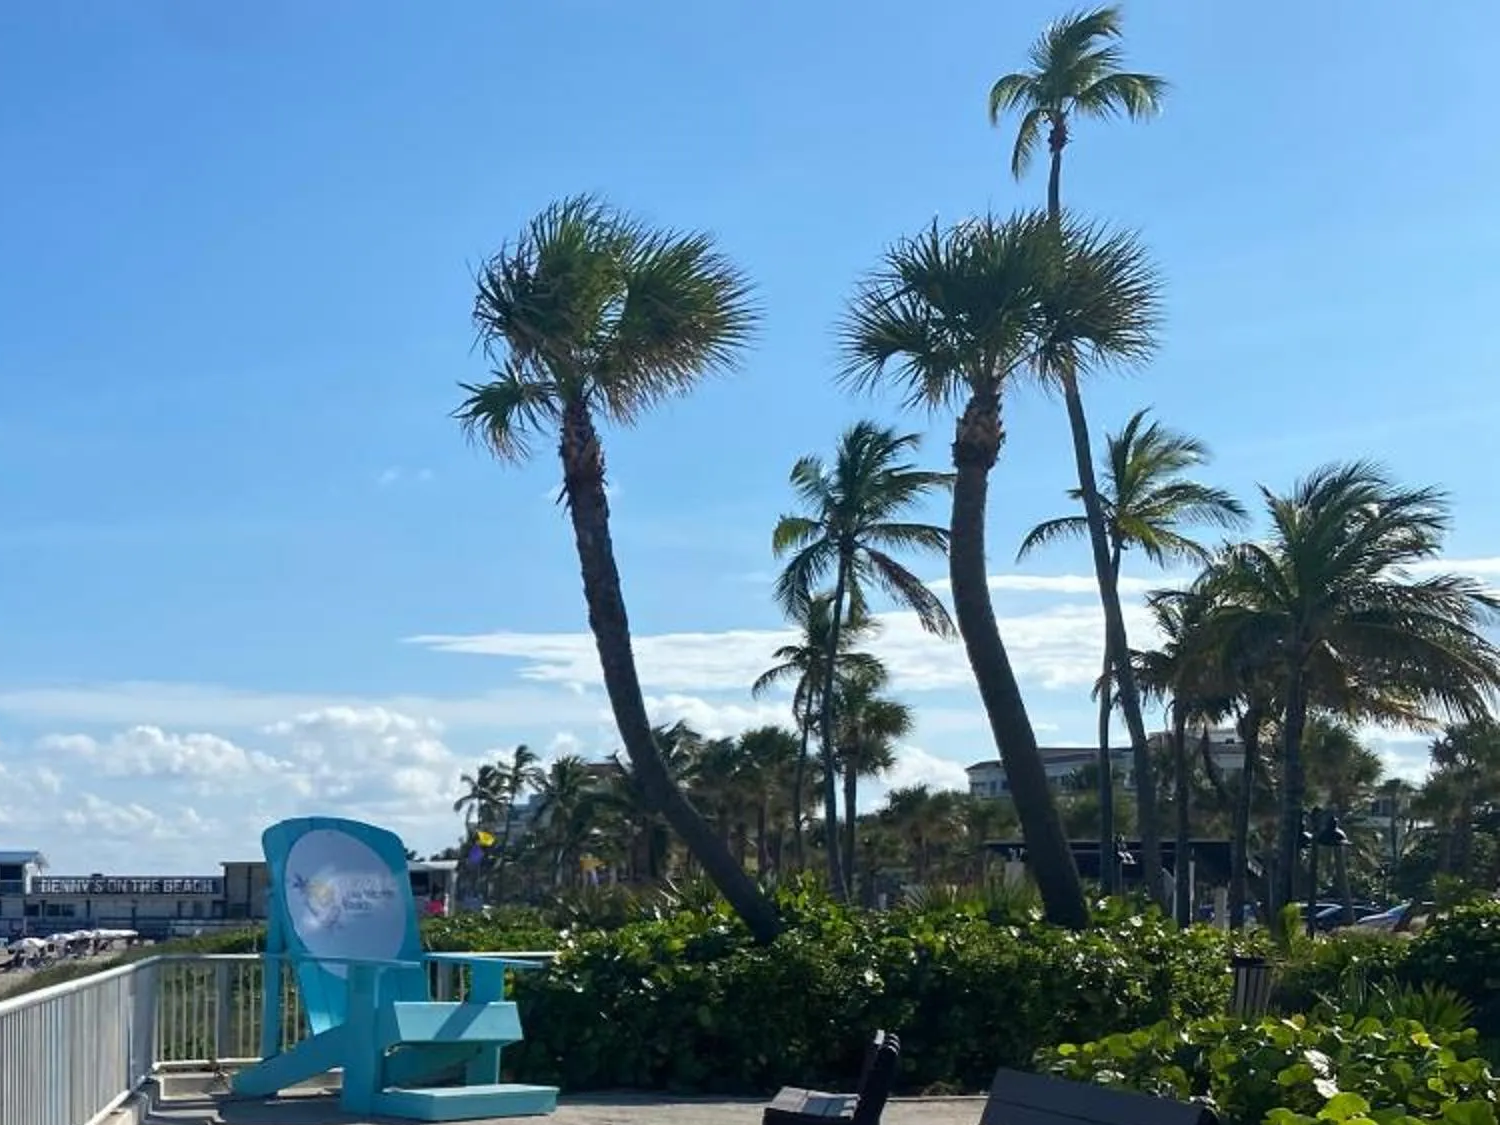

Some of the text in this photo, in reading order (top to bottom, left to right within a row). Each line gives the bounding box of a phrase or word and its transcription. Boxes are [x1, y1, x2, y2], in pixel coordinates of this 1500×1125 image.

[107, 879, 127, 894] ON
[132, 879, 159, 894] THE
[163, 879, 214, 894] BEACH
